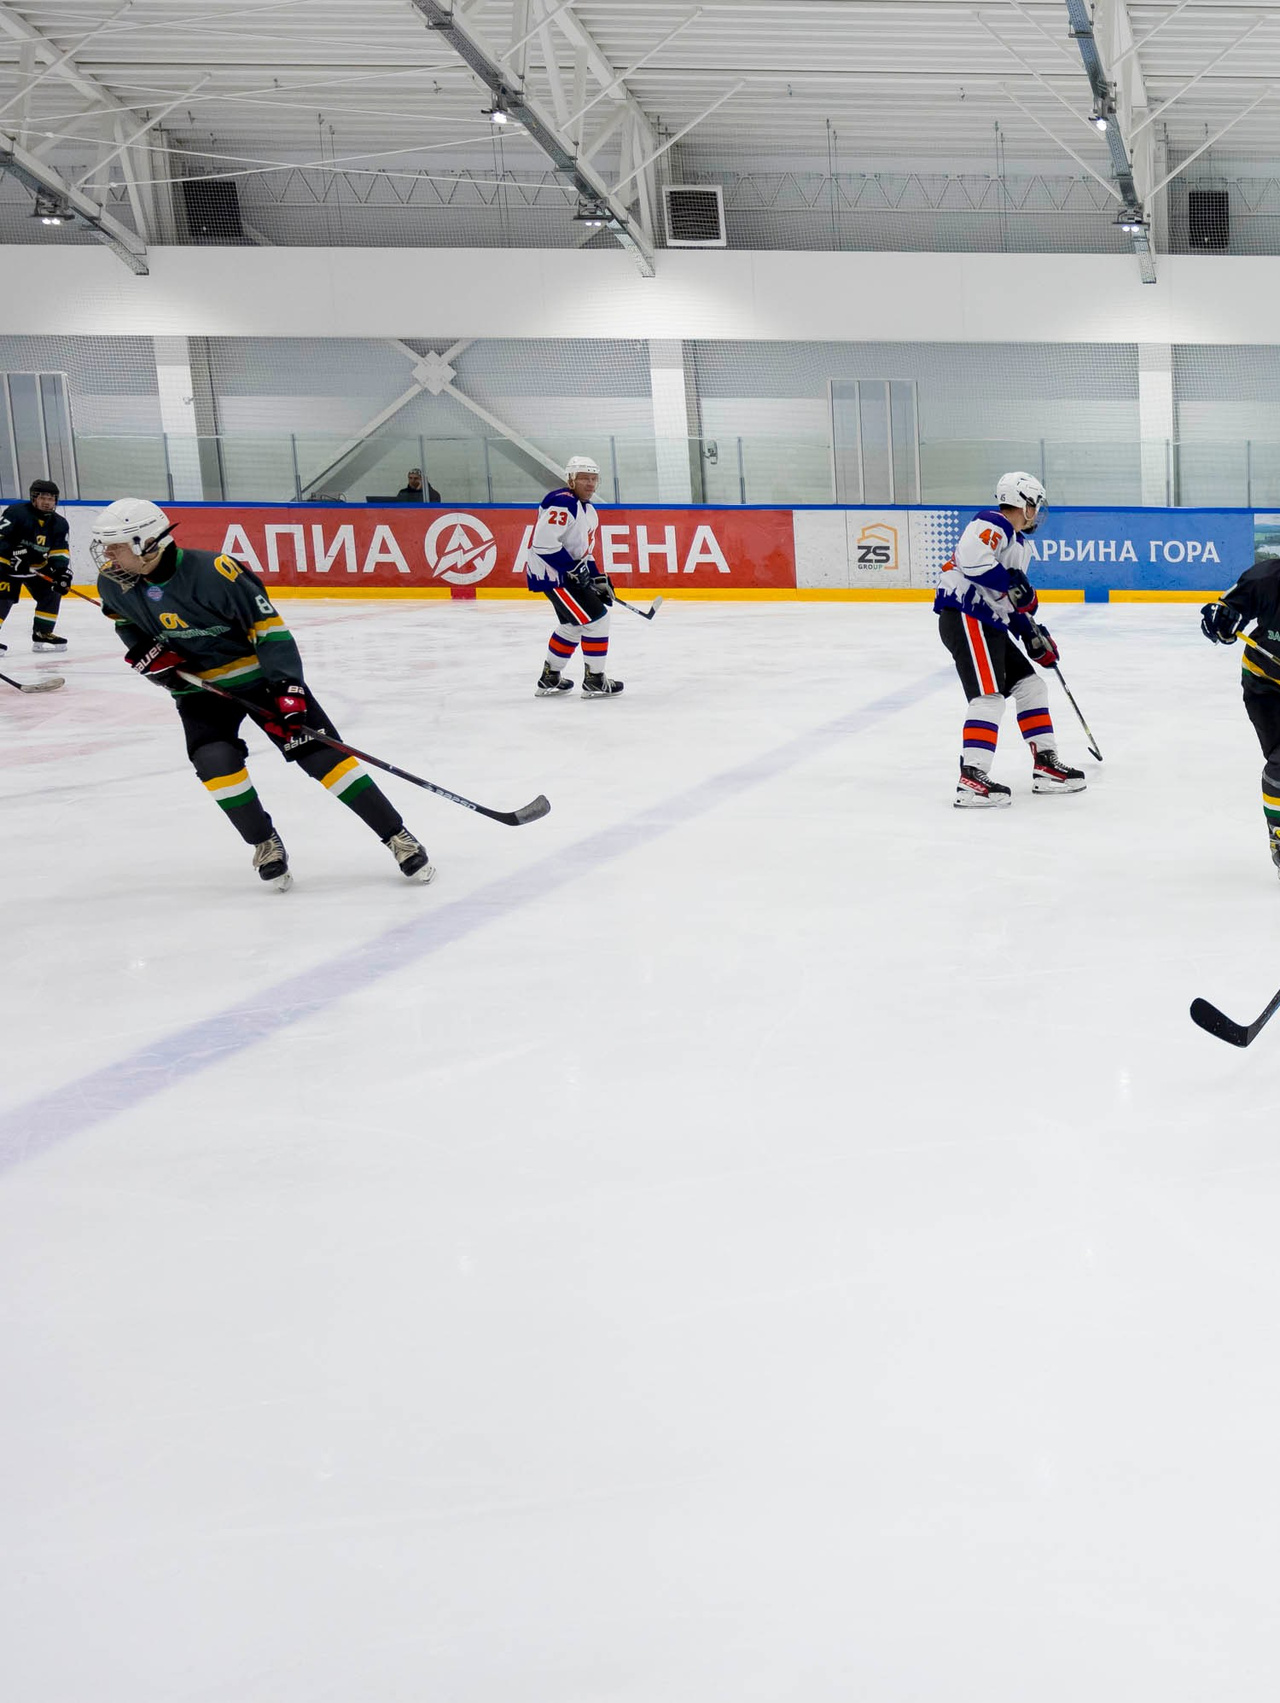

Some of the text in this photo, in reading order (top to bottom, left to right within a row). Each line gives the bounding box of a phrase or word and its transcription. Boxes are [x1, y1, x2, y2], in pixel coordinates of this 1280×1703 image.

[547, 510, 568, 526] 23
[221, 523, 731, 574] АПИА ЕНА
[979, 528, 1003, 551] 45
[857, 545, 891, 564] ZS
[1149, 540, 1221, 563] ГОРА
